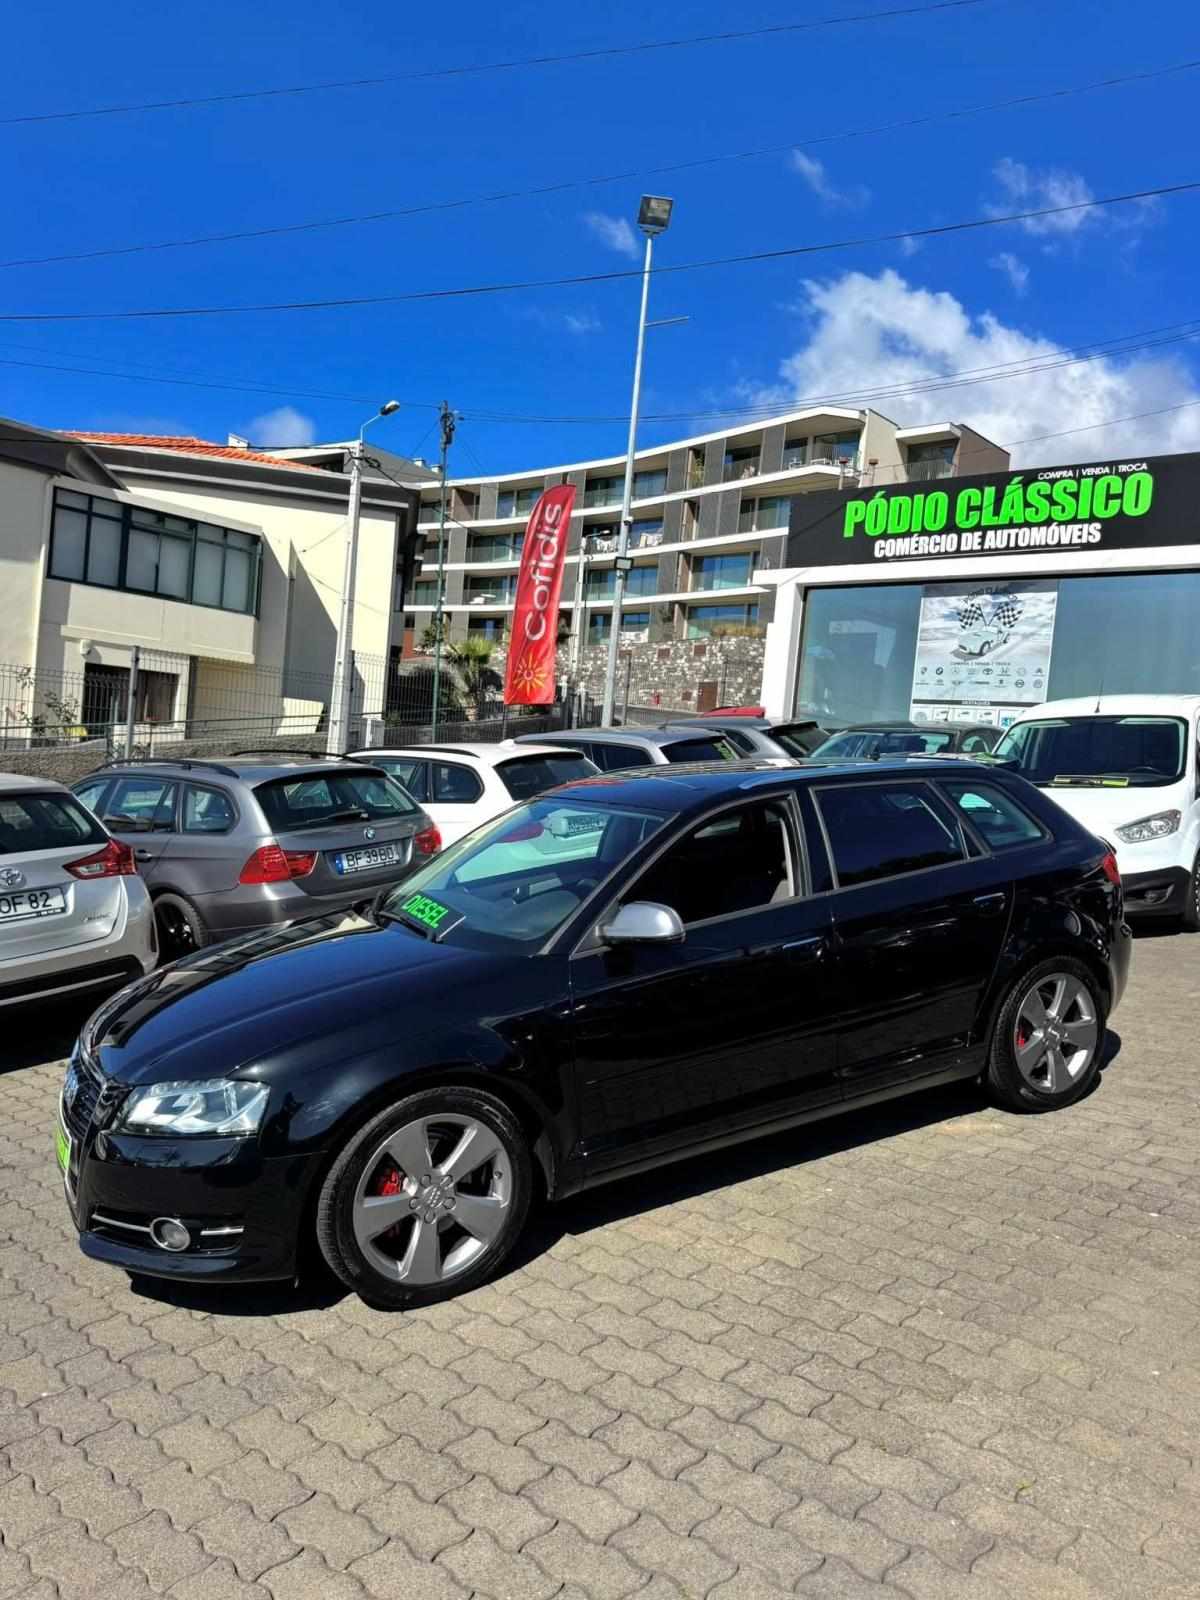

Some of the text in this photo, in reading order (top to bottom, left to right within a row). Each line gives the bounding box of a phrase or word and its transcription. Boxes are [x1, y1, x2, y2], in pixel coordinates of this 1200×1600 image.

[1038, 462, 1148, 480] COMPRA VENDA TROCA
[843, 476, 1153, 537] PÓDIO CLÁSSICO
[874, 522, 1102, 558] COMÉRCIO DE AUTOMÓVEIS
[525, 503, 562, 641] Cofidis
[28, 891, 52, 909] 82
[401, 894, 449, 929] DIESEL
